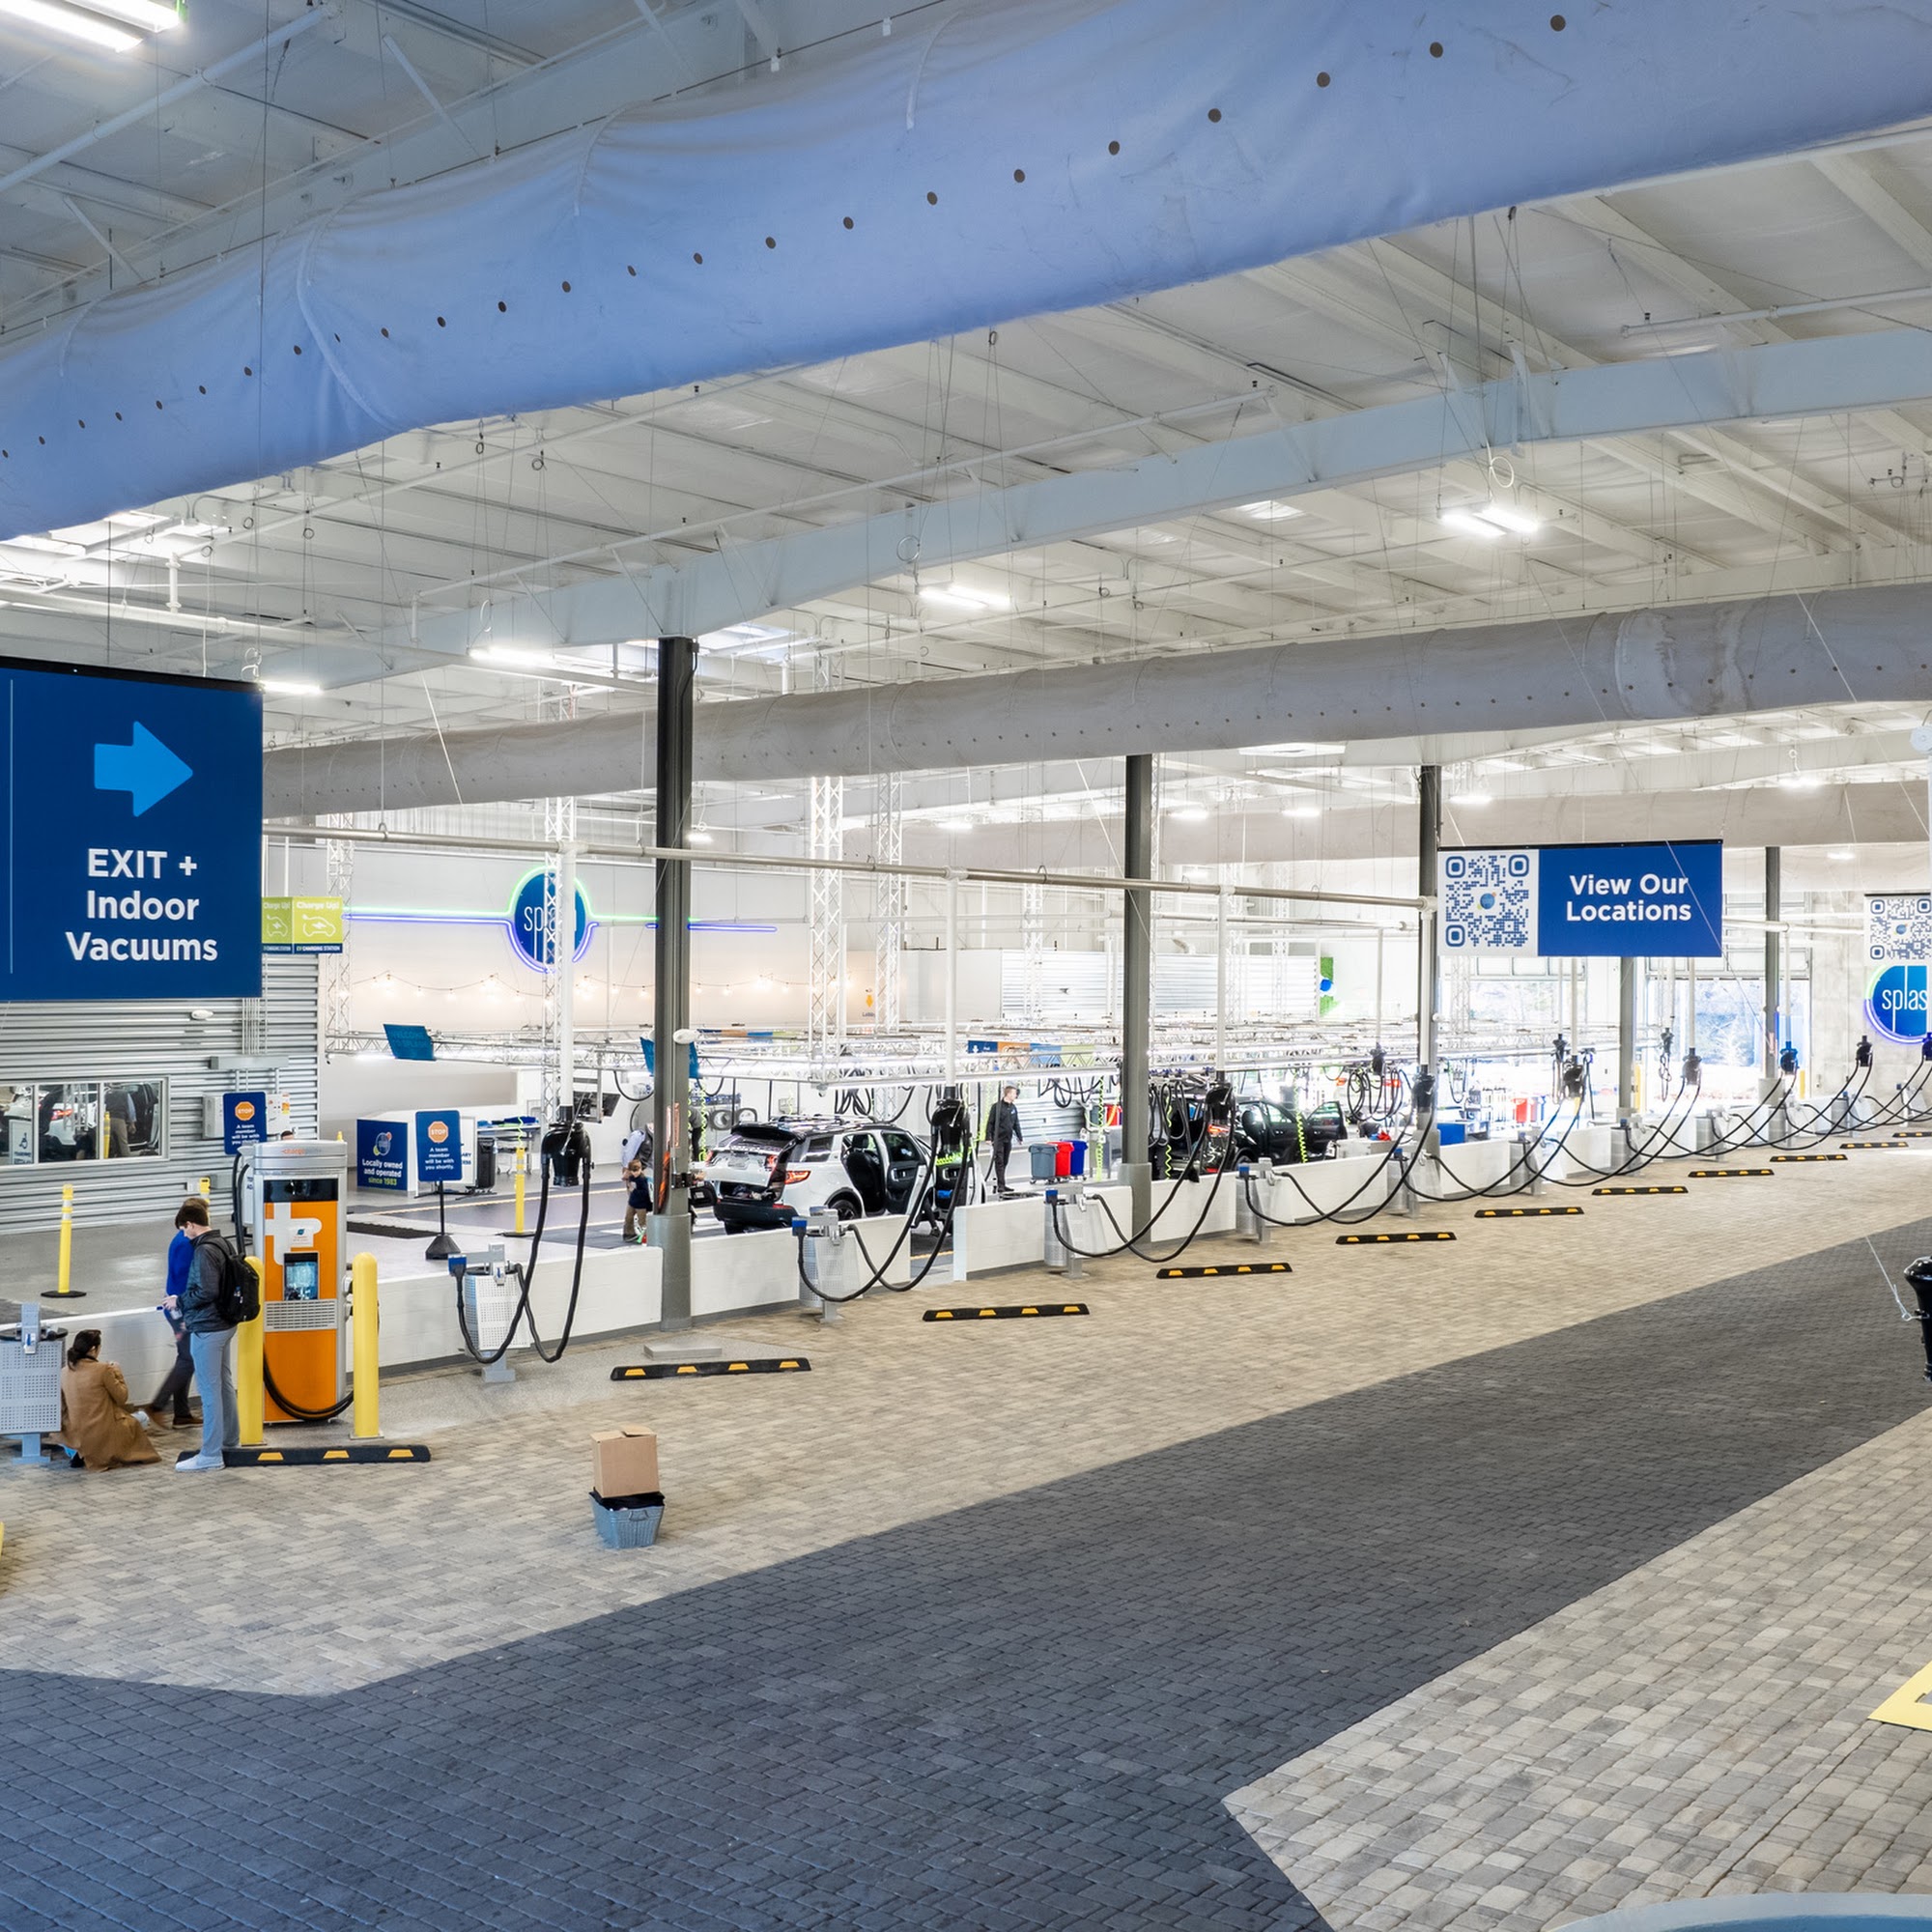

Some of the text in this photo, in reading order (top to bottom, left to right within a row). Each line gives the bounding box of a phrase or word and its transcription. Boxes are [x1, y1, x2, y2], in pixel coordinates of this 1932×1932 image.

[88, 848, 198, 879] EXIT +
[1569, 873, 1689, 895] View Our
[87, 890, 199, 921] Indoor
[1566, 899, 1691, 922] Locations
[65, 931, 218, 961] Vacuums
[362, 1159, 383, 1168] Locally
[376, 1169, 402, 1178] operated
